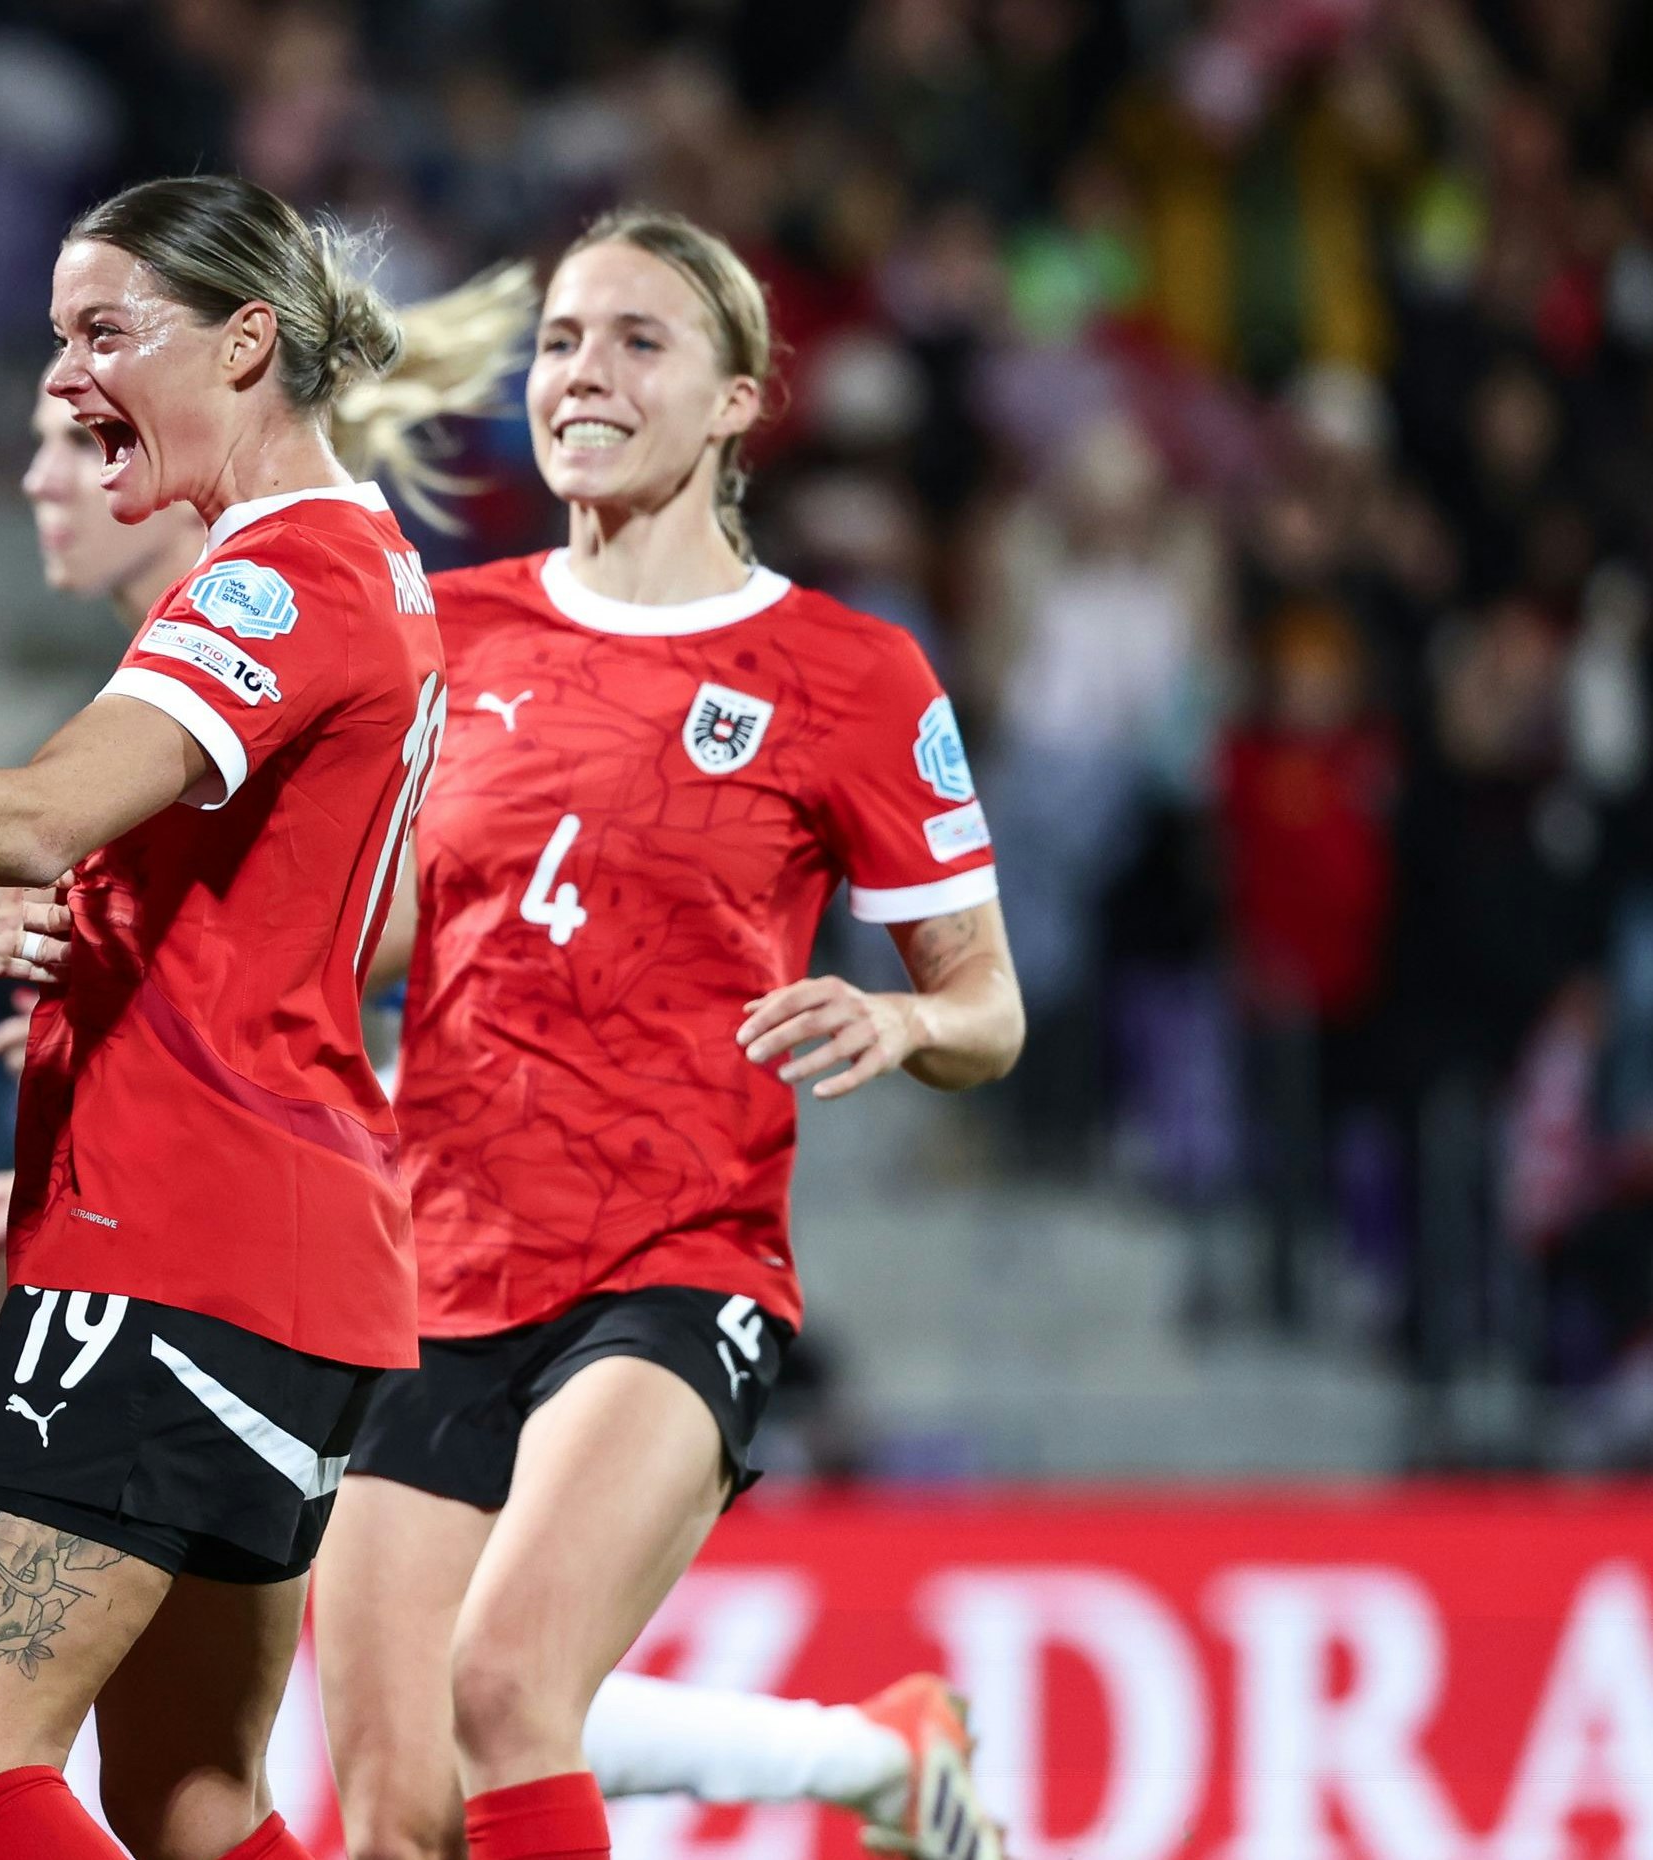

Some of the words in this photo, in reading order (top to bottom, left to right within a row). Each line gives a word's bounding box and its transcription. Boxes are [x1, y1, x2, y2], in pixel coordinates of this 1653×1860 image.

[229, 579, 246, 590] We
[222, 593, 261, 616] Strong
[520, 814, 587, 946] 4
[70, 1208, 118, 1229] ULTRAWEAVE
[14, 1284, 130, 1389] 19
